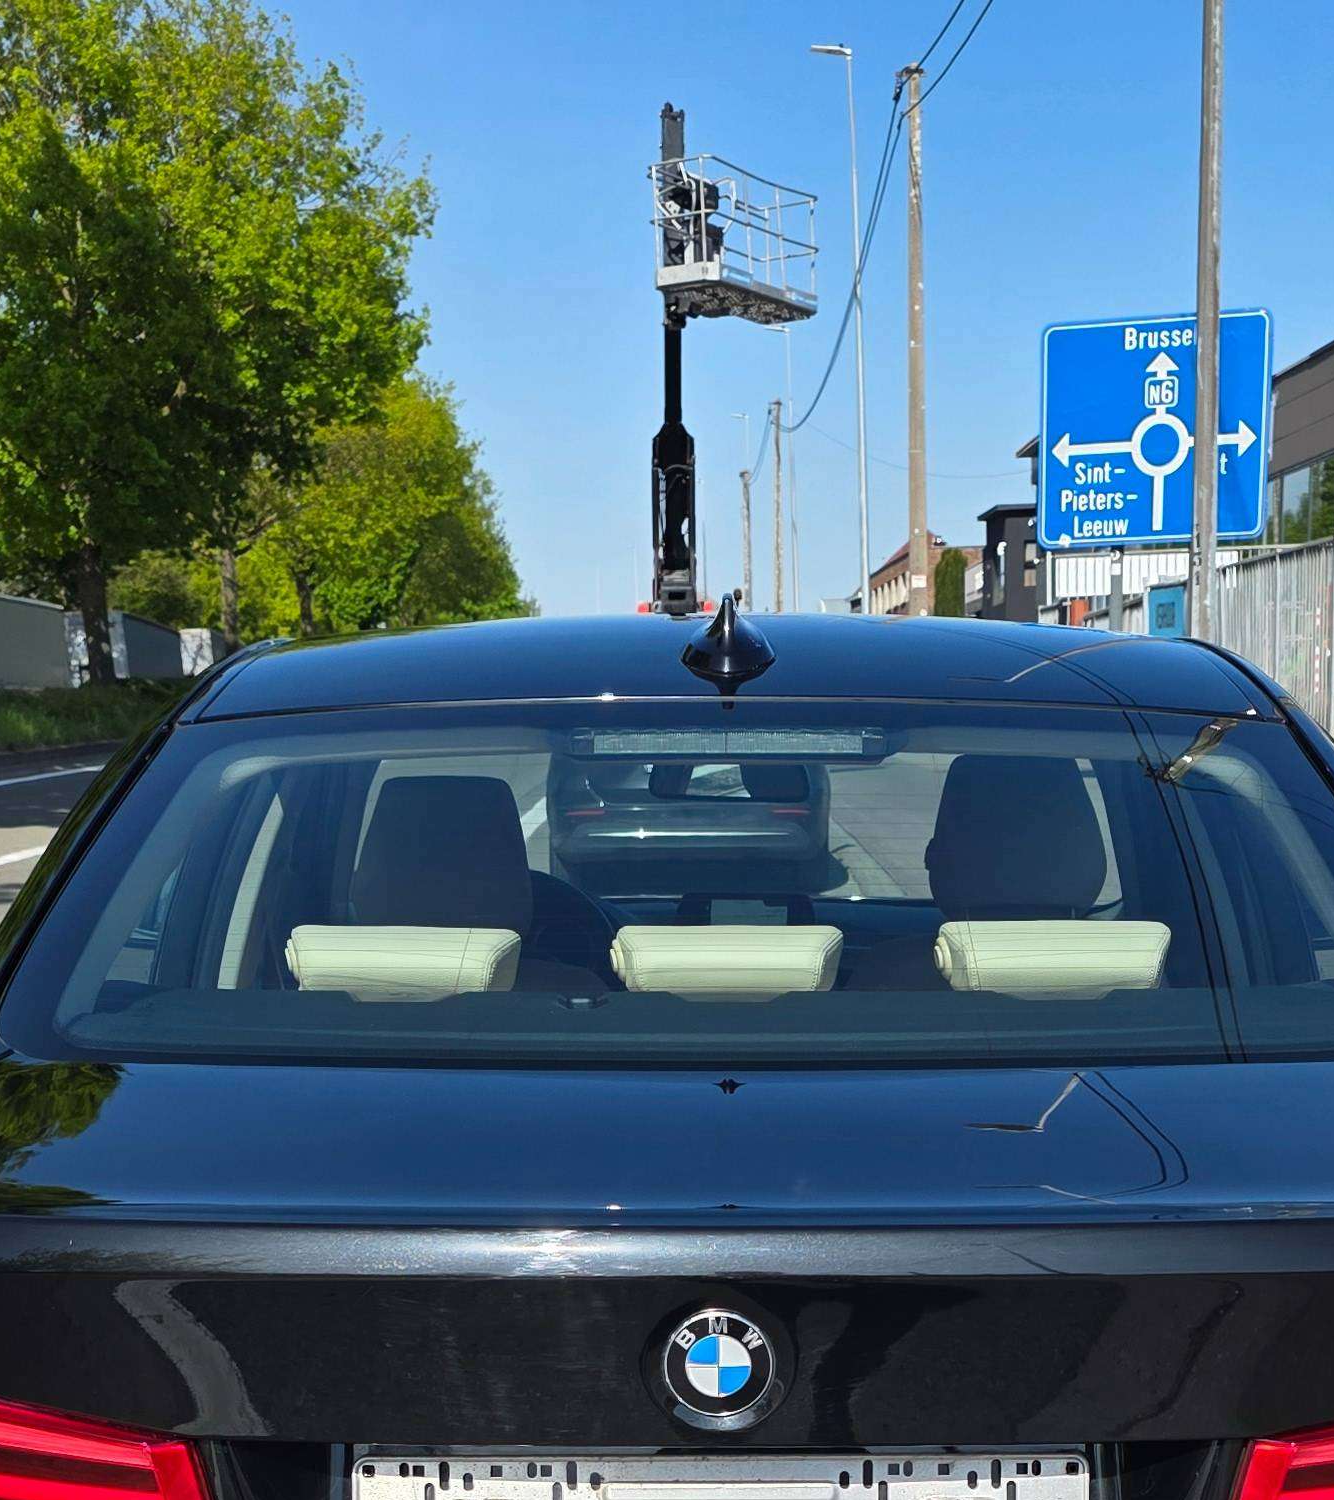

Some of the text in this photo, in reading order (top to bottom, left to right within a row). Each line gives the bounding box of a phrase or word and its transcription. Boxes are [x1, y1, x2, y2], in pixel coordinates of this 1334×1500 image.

[1124, 327, 1197, 350] Brusse
[1149, 381, 1173, 404] N6
[1074, 462, 1126, 485] Sint-
[1061, 490, 1138, 512] Pieters-
[1073, 516, 1129, 538] Leeuw
[675, 1315, 764, 1350] BMW
